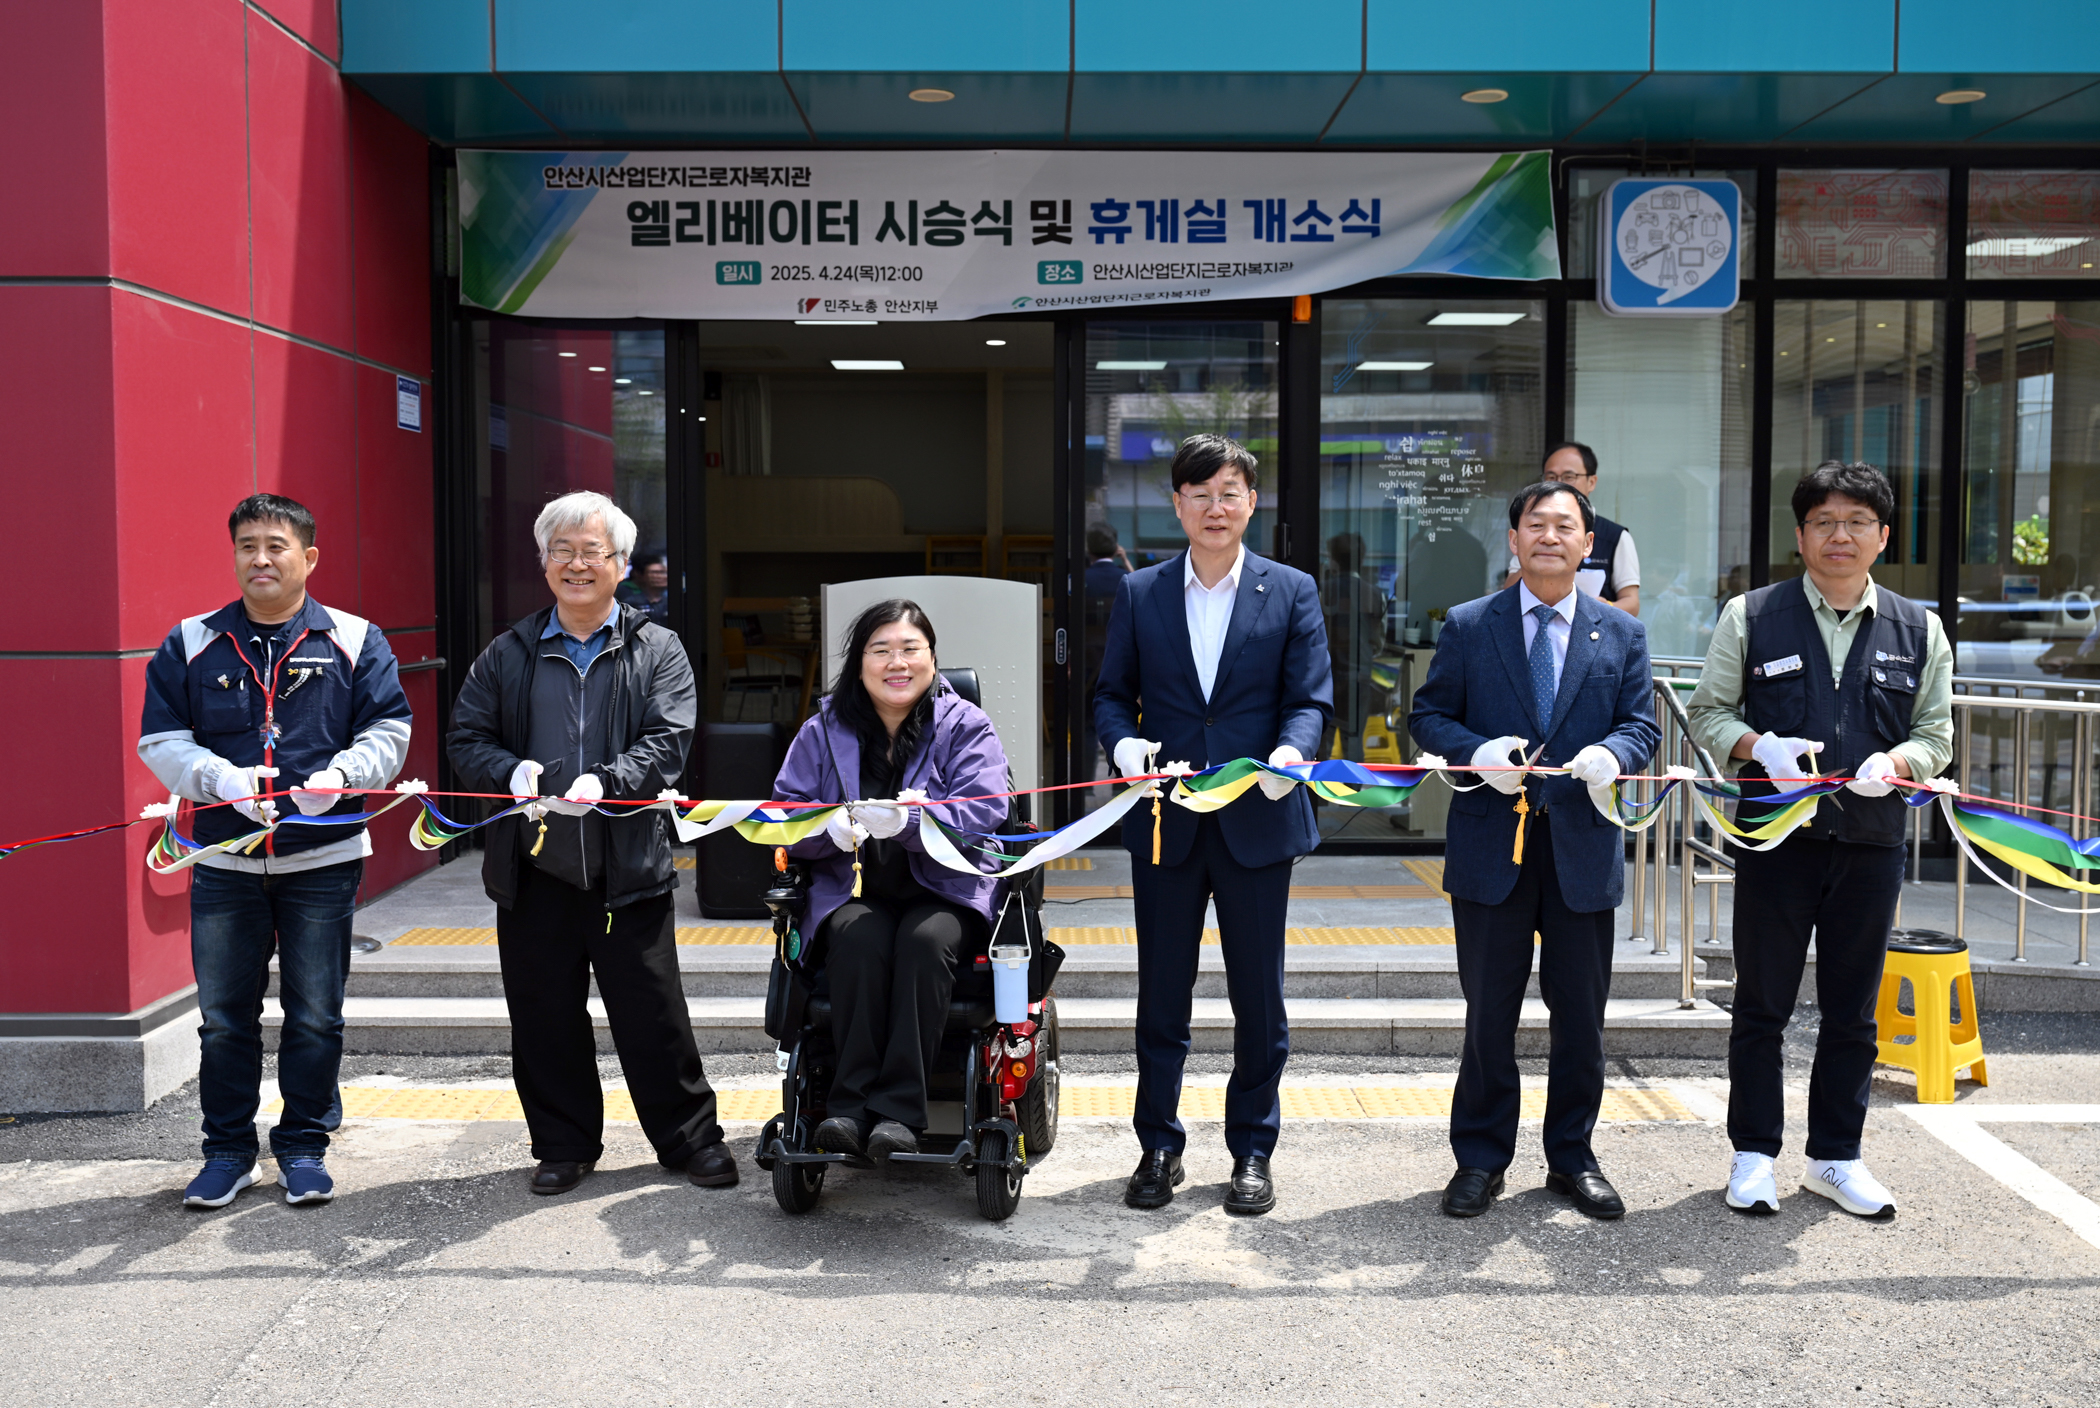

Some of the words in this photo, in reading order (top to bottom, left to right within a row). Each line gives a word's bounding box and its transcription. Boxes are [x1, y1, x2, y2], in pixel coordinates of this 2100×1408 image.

[543, 165, 812, 189] 안산시산업단지근로자복지관
[626, 200, 859, 247] 엘리베이터
[875, 200, 1013, 247] 시승식
[1030, 199, 1074, 246] 및
[1087, 197, 1228, 245] 휴게실
[1243, 197, 1382, 243] 개소식
[721, 264, 754, 283] 일시
[1044, 264, 1077, 282] 장소
[1093, 261, 1294, 281] 안산시산업단지근로자복지관
[824, 299, 878, 314] 민주노총
[884, 299, 939, 314] 안산지부
[1035, 288, 1212, 308] 안산시산업단지근로자복지관
[1384, 453, 1402, 461] relax
[1450, 448, 1476, 456] reposer
